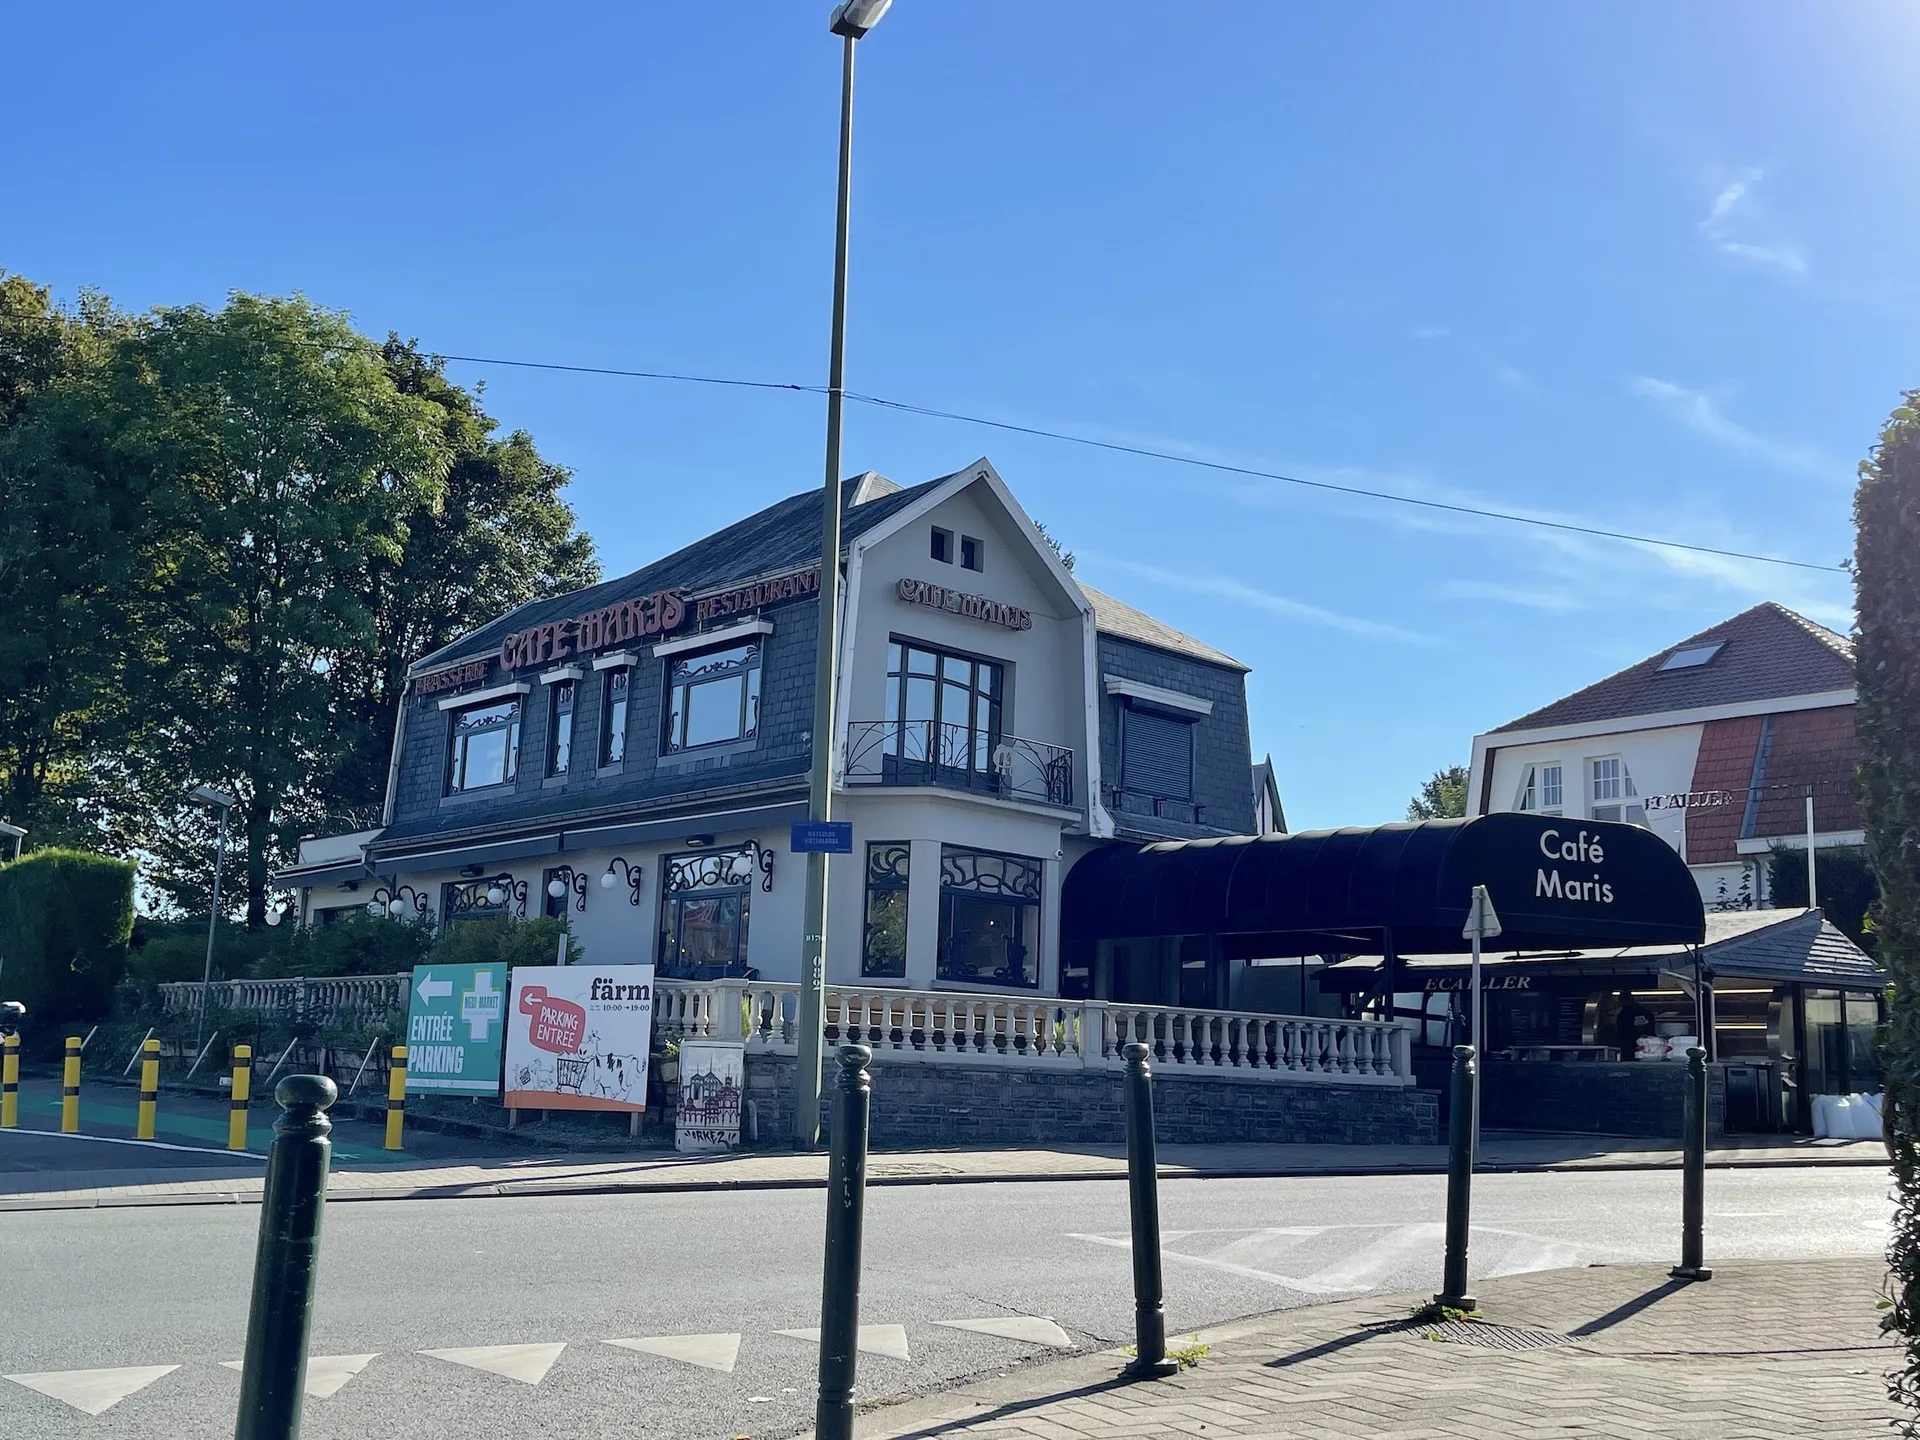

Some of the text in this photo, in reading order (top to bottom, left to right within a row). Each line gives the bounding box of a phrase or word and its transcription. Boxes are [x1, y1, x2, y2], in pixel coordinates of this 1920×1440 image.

[696, 569, 821, 620] RESTAURANT
[500, 619, 571, 671] CAFE
[1539, 829, 1605, 864] Café
[1535, 868, 1615, 904] Maris
[590, 977, 651, 1001] färm
[539, 1005, 579, 1031] PARKING
[603, 1004, 622, 1012] 10:00
[631, 1004, 650, 1012] 19:00
[411, 1010, 454, 1042] ENTRÉE
[536, 1023, 576, 1049] ENTREE
[407, 1045, 465, 1074] PARKING
